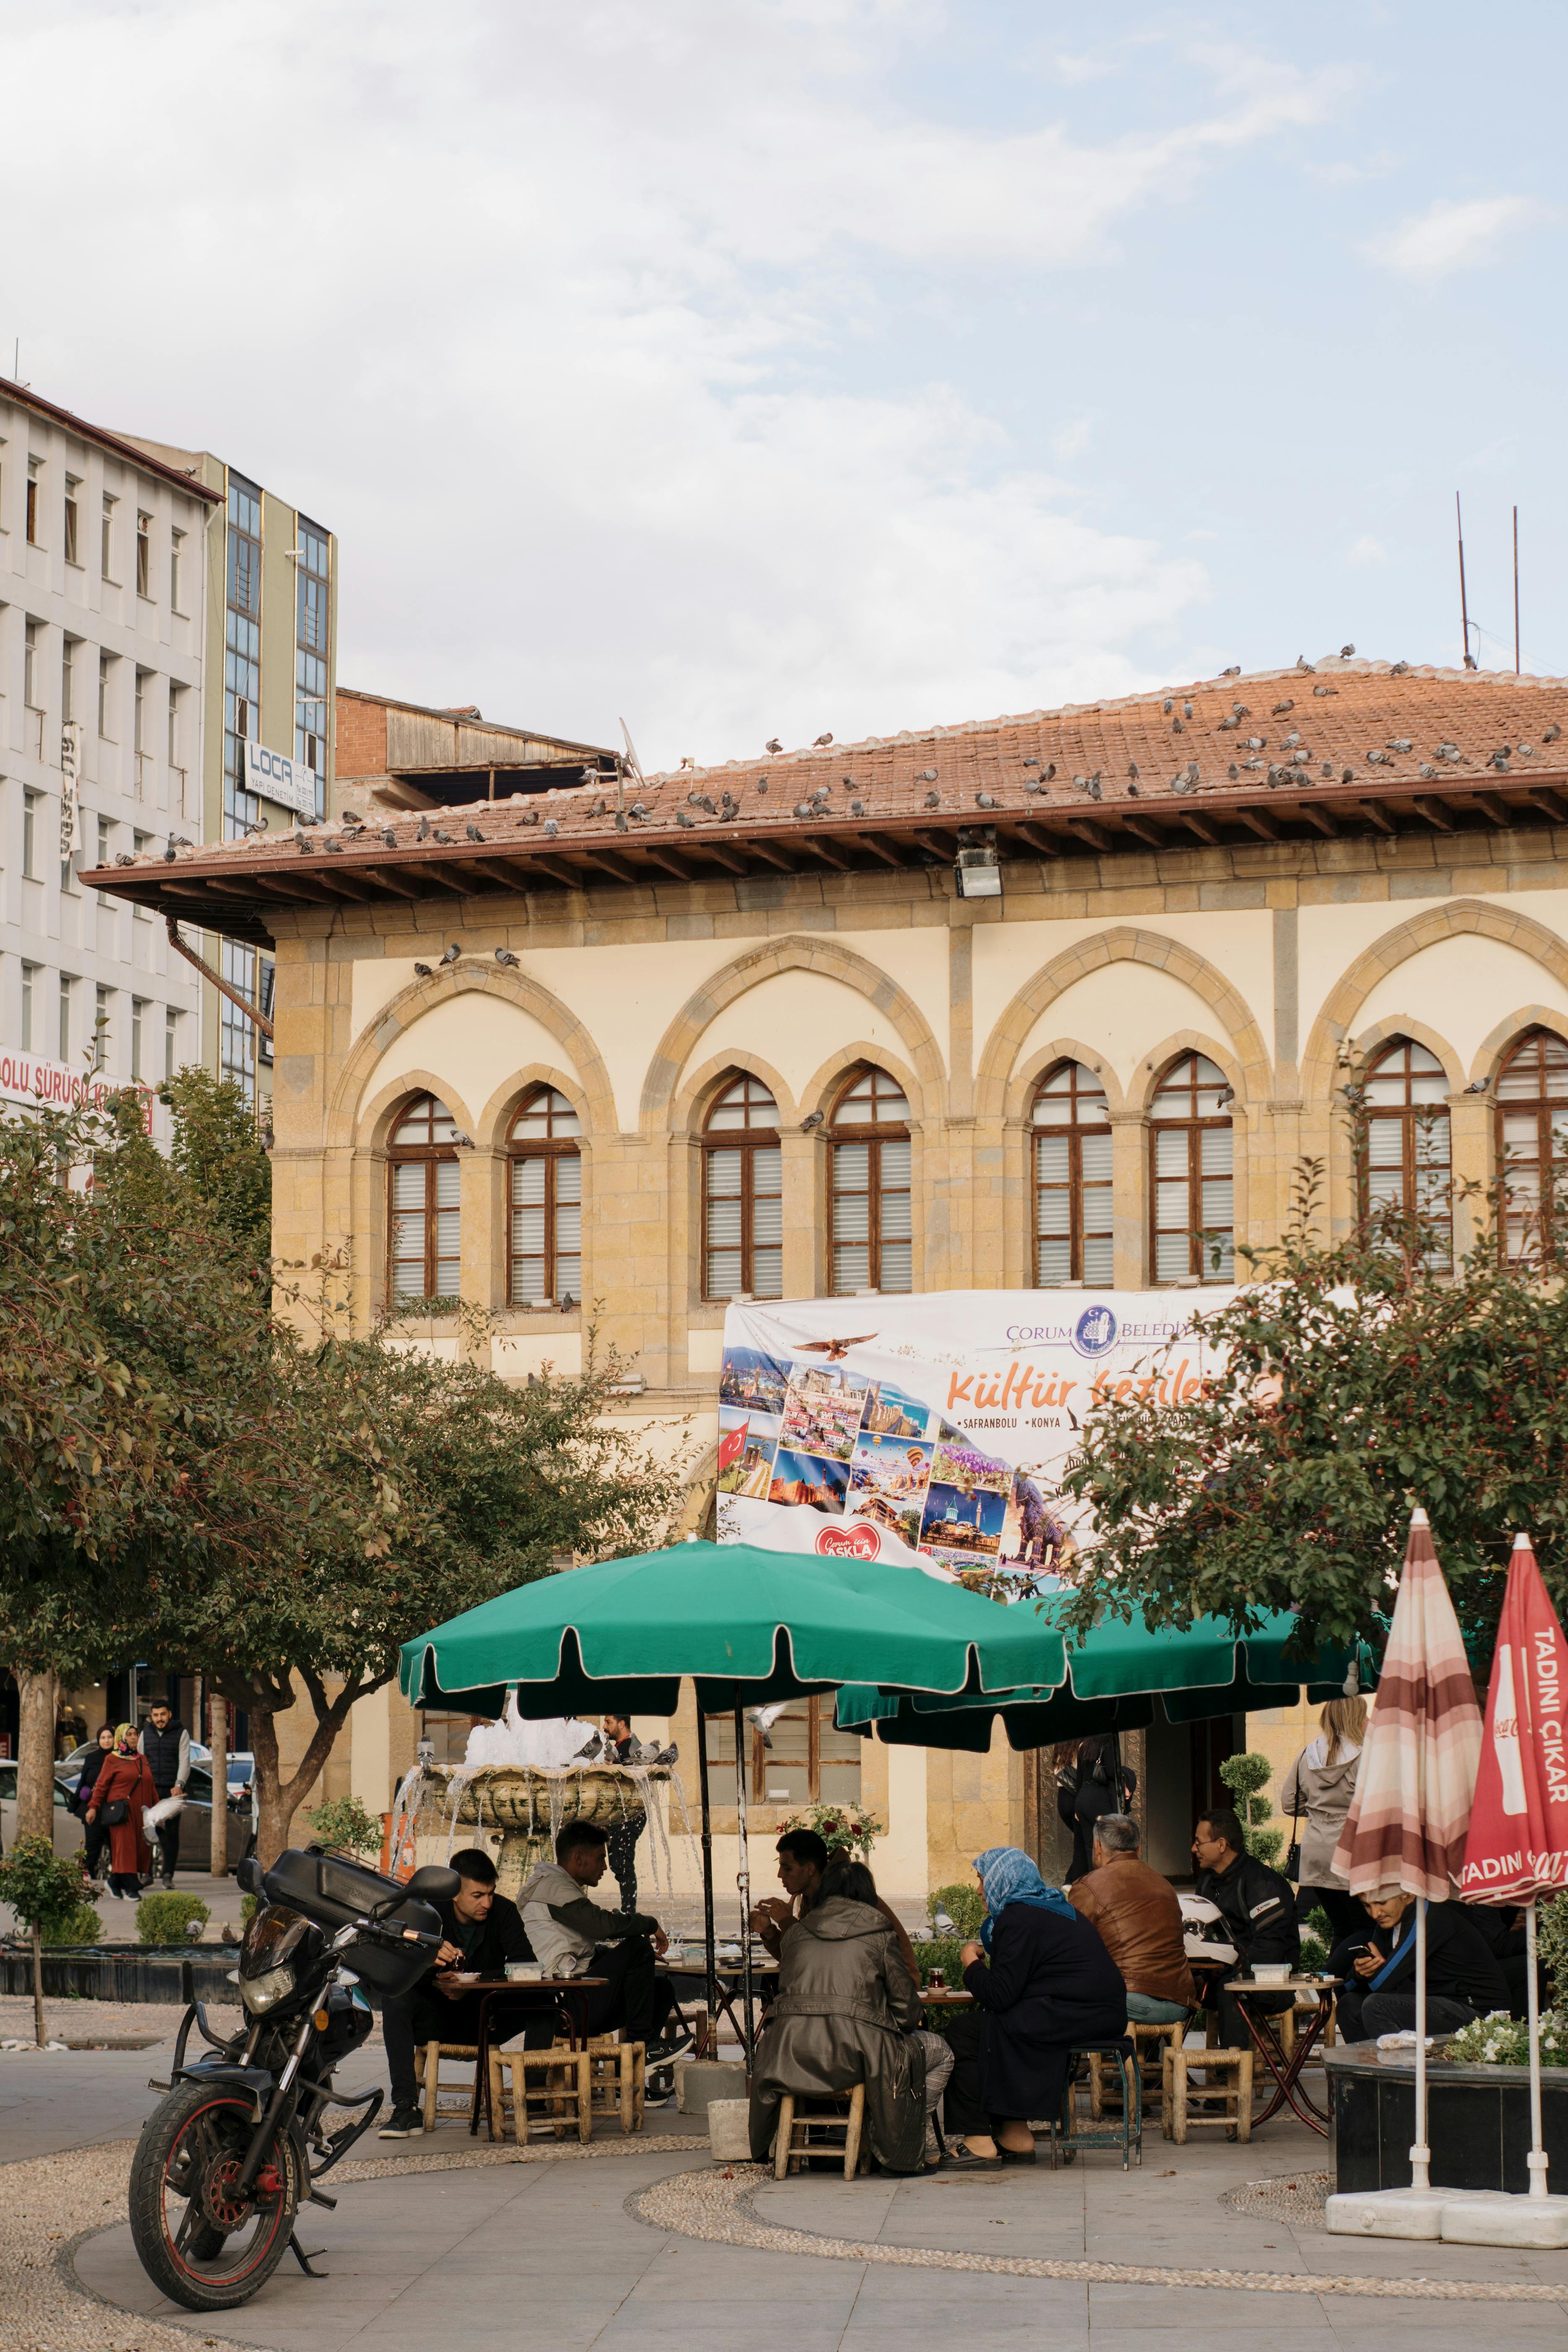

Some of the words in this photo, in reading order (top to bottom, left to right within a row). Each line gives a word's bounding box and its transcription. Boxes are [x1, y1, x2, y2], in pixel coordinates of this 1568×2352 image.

[251, 744, 292, 786] LOCA
[251, 778, 264, 791] YAPI
[267, 785, 293, 804] DENETİM
[0, 1057, 29, 1093] OLU
[1006, 1326, 1072, 1343] ÇORUM
[947, 1362, 1078, 1410] Kültür
[964, 1418, 1017, 1428] SAFRANBOLU
[1032, 1417, 1060, 1428] KONYA
[1534, 1626, 1560, 1714] TADINI
[1539, 1720, 1568, 1804] ÇIKAR
